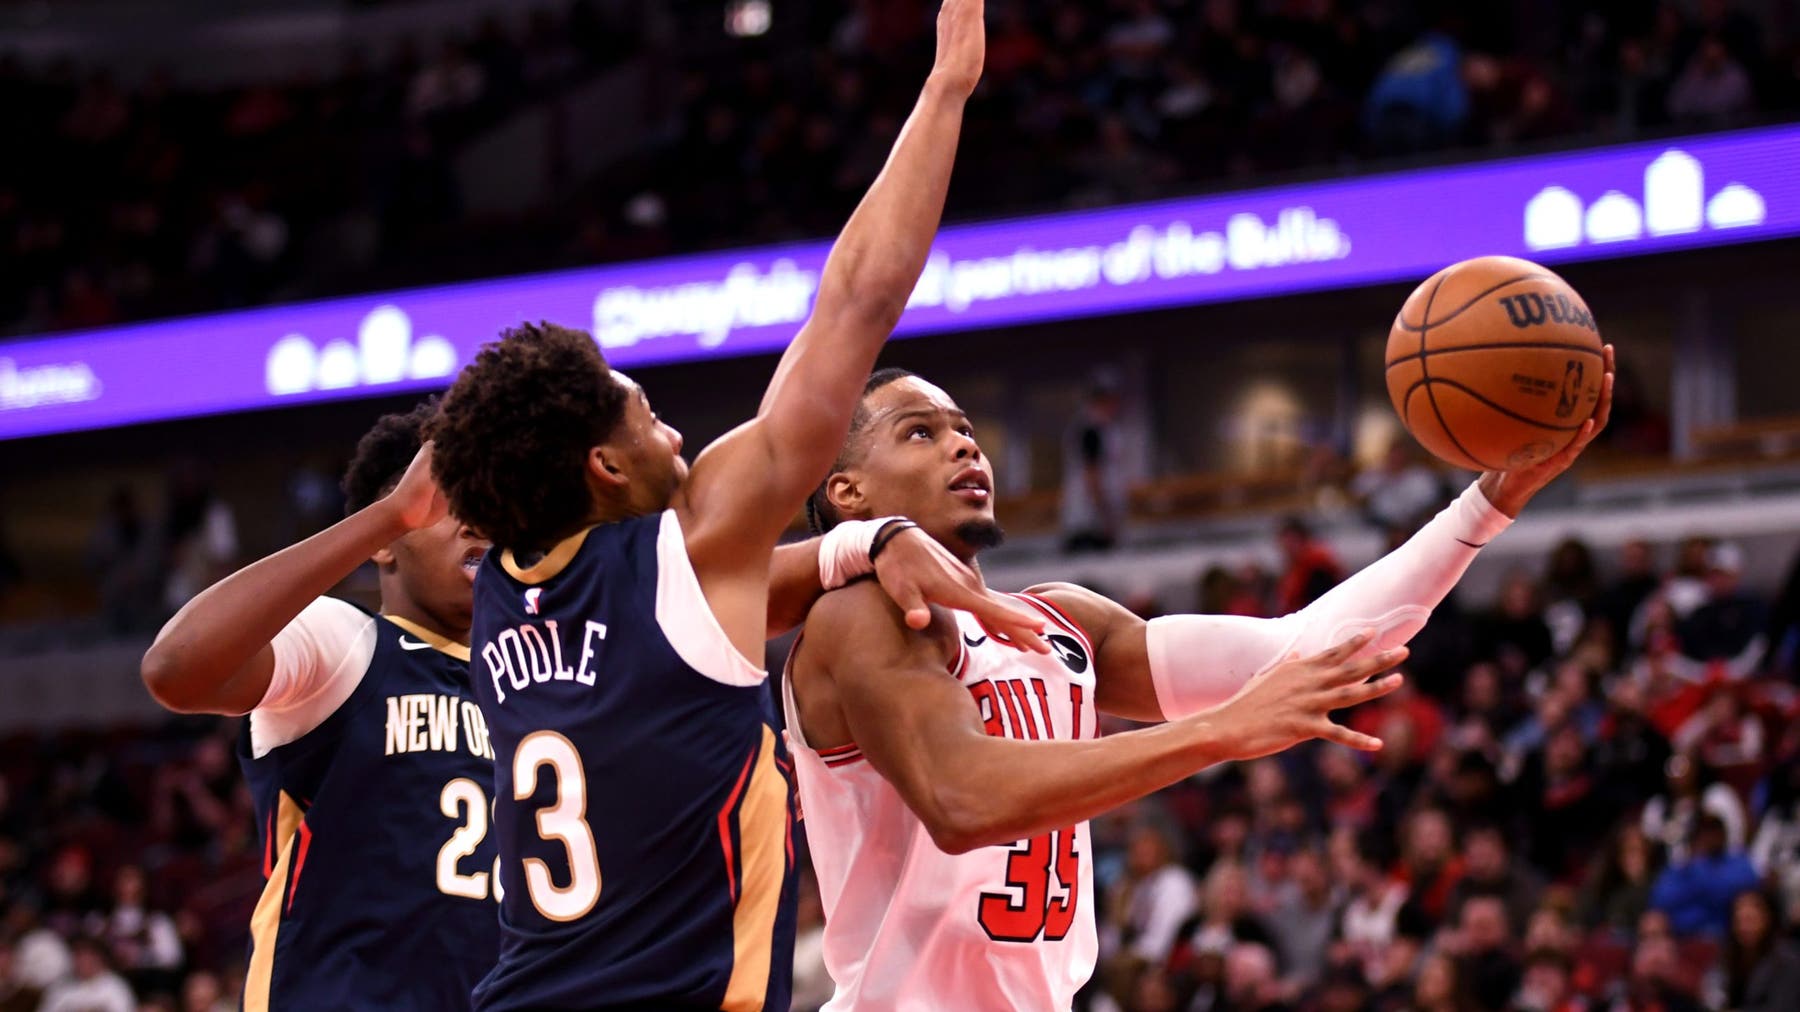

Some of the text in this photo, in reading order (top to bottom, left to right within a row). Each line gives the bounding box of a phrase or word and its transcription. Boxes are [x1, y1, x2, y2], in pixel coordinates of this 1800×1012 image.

[1103, 225, 1151, 285] of
[1152, 221, 1226, 280] the
[482, 619, 607, 704] POOLE
[385, 694, 460, 756] NEW
[436, 777, 505, 903] 2
[513, 730, 602, 922] 3
[977, 824, 1079, 943] 35
